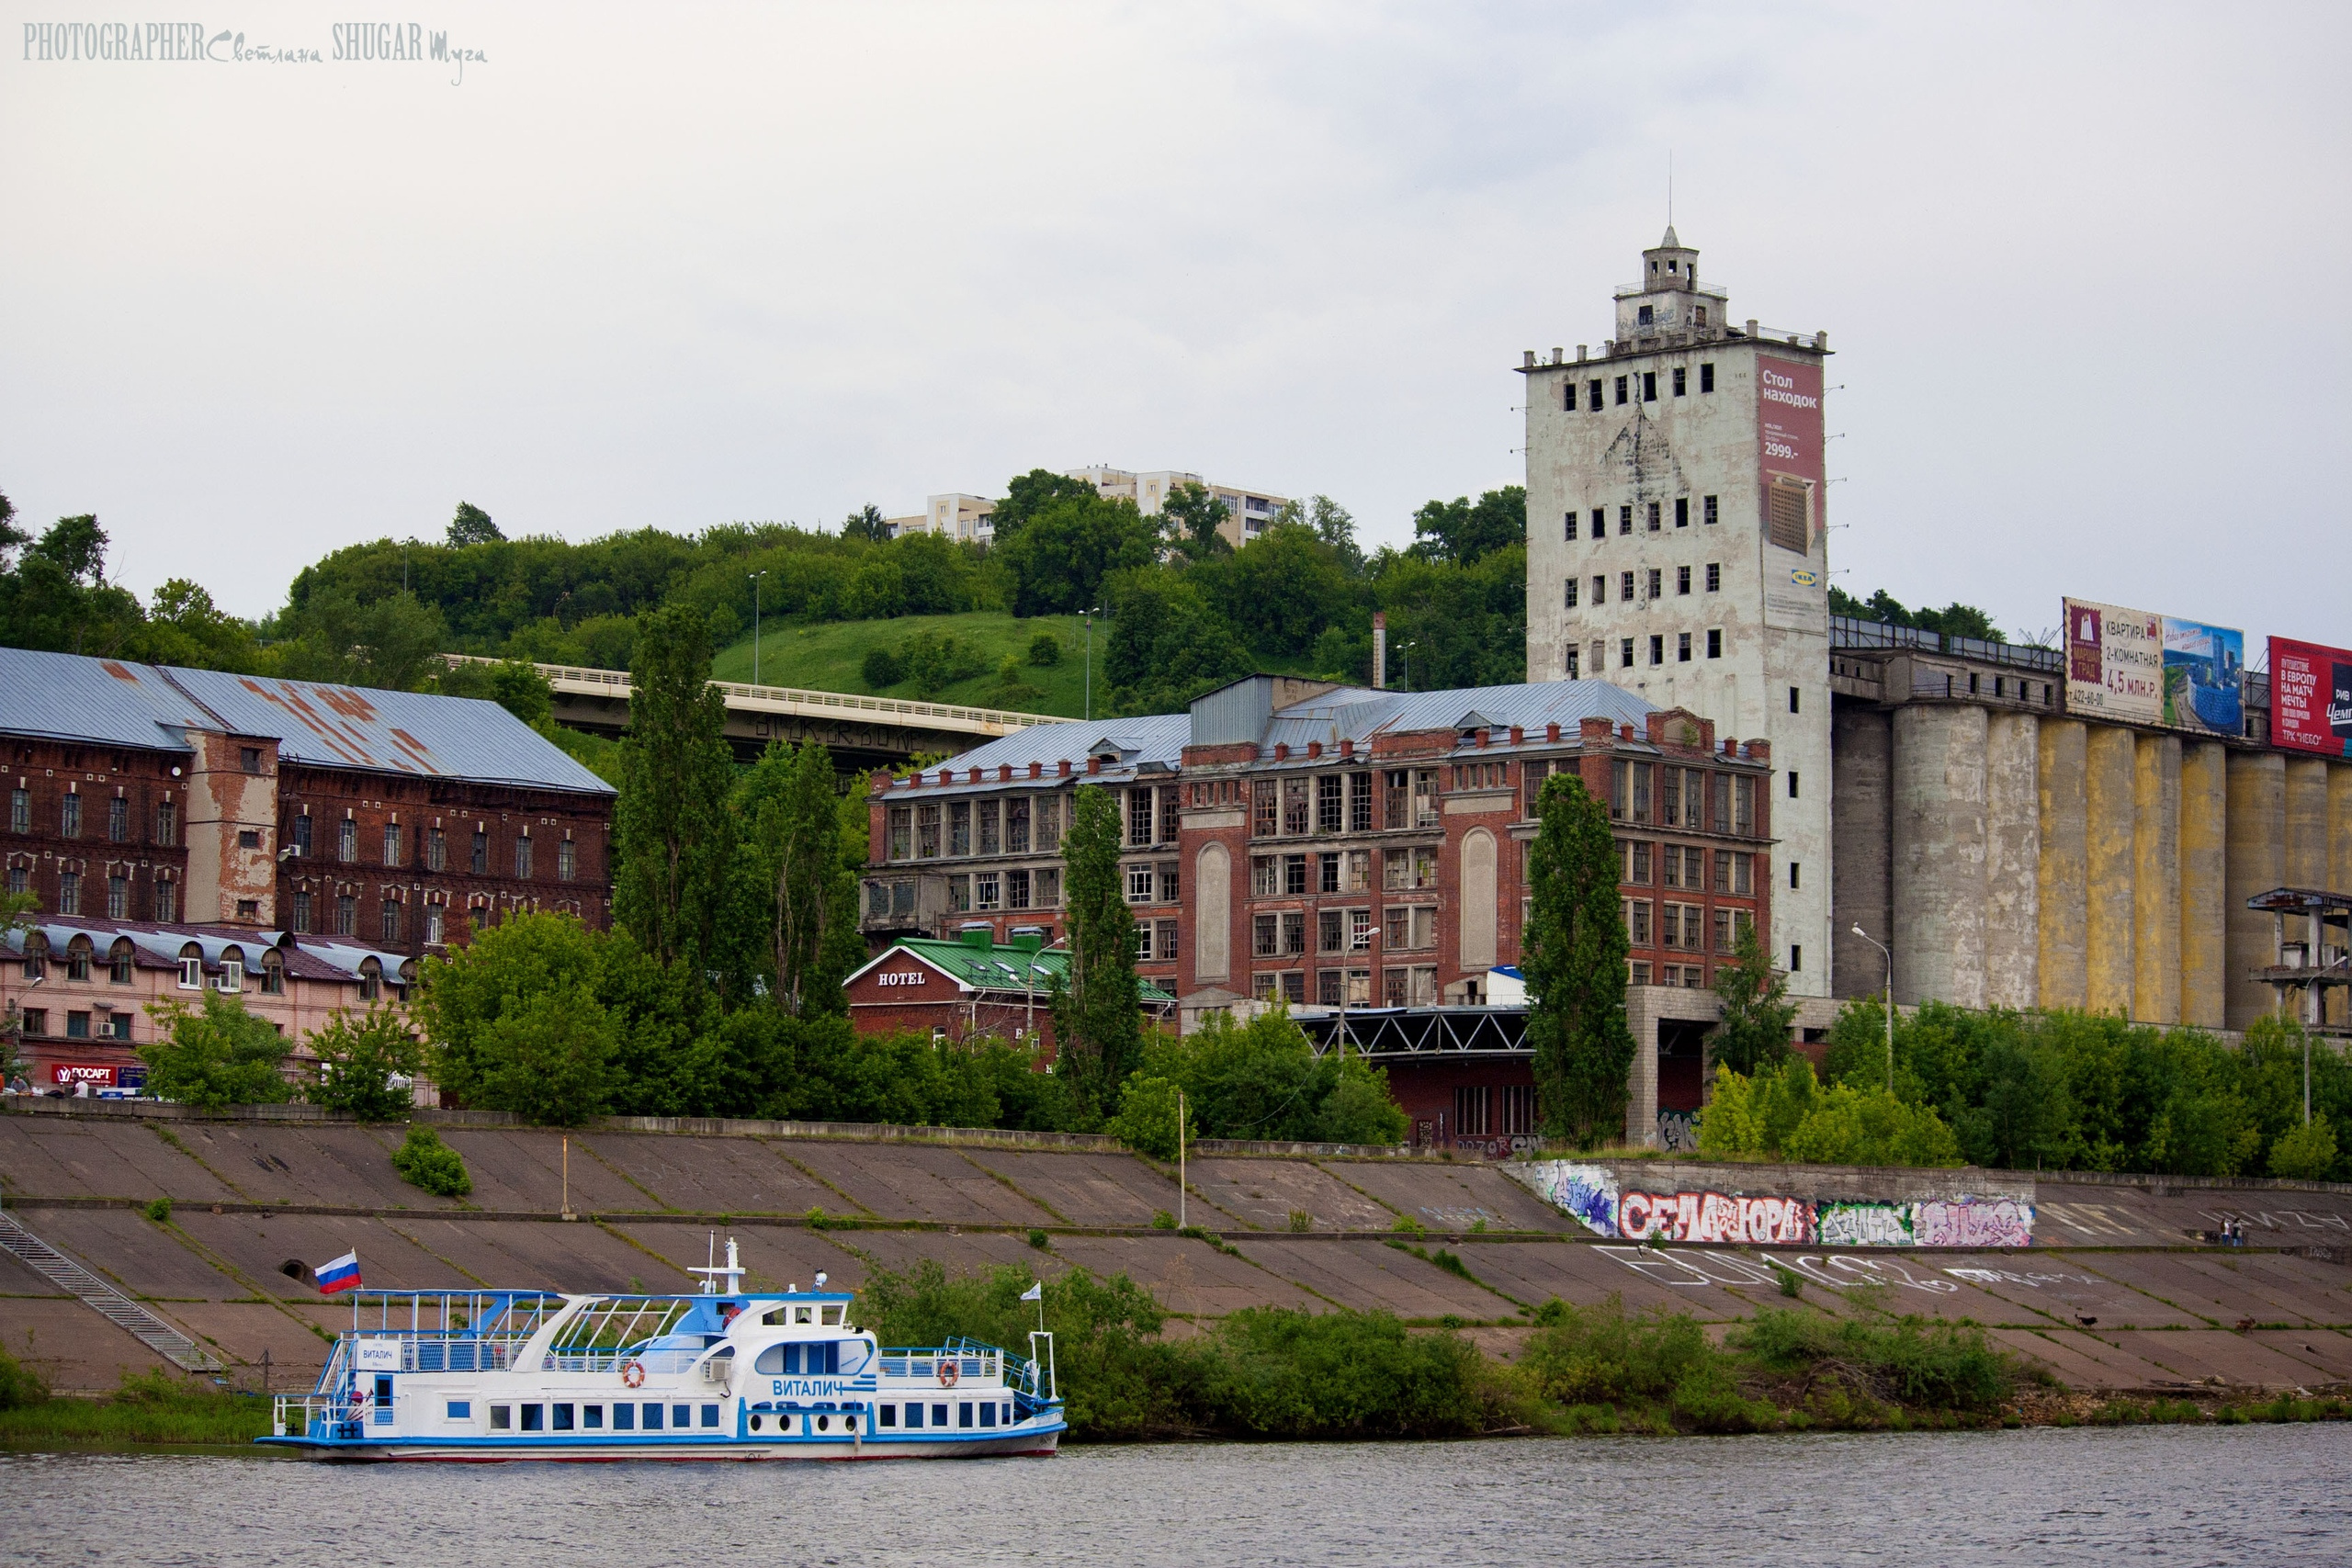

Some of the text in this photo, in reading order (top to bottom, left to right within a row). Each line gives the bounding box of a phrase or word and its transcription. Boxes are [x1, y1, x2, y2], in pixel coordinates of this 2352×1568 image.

[1763, 369, 1793, 389] Стол
[1763, 388, 1817, 409] находок
[2106, 620, 2146, 641] КВАРТИРА
[2107, 646, 2158, 669] 2-КОМНАТНАЯ
[2077, 661, 2096, 679] ГРАД
[2281, 670, 2317, 686] В ЕВРОПУ
[2108, 669, 2124, 695] 4,5
[2281, 682, 2312, 697] НА МАТЧ
[2281, 694, 2307, 708] МЕЧТЫ
[2282, 729, 2296, 742] ТРК
[878, 972, 925, 987] HOTEL
[363, 1349, 392, 1359] ВИТАЛИЧ
[773, 1380, 842, 1396] ВИТАЛИЧ
